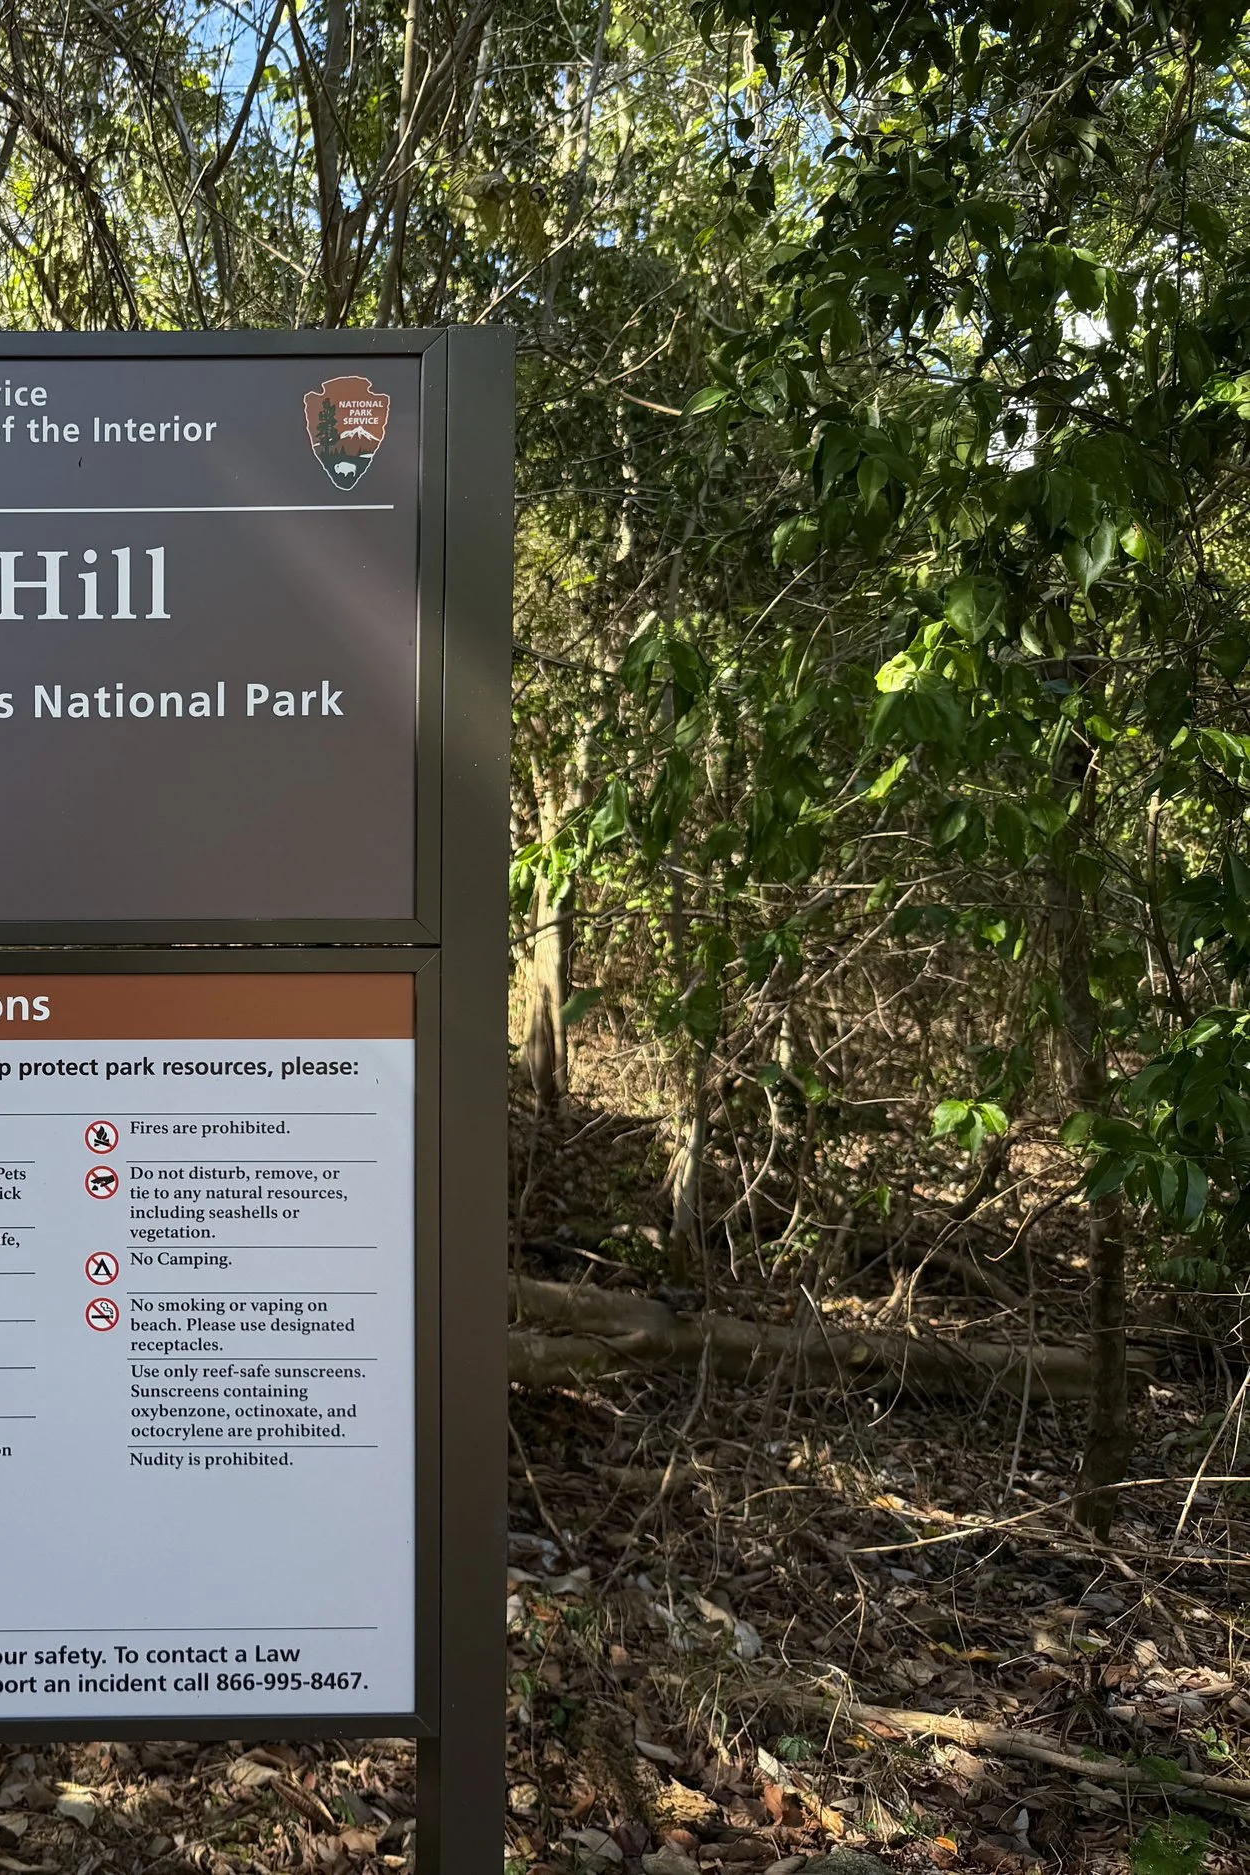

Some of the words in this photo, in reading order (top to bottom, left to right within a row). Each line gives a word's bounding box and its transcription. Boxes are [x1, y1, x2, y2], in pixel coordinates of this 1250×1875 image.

[338, 399, 384, 409] NATIONAL
[348, 408, 373, 417] PARK
[26, 415, 81, 444] the
[93, 414, 218, 443] Interior
[342, 416, 380, 426] SERVICE
[34, 680, 226, 719] National
[246, 679, 345, 717] Park
[18, 1058, 99, 1082] protect
[105, 1056, 156, 1081] park
[162, 1061, 274, 1078] resources,
[281, 1055, 359, 1081] please:
[129, 1120, 169, 1135] Fires
[172, 1124, 198, 1135] are
[201, 1120, 291, 1139] prohibited.
[129, 1166, 155, 1180] Do
[157, 1167, 185, 1180] not
[188, 1165, 251, 1183] disturb,
[254, 1169, 318, 1183] remove,
[322, 1169, 341, 1180] or
[129, 1185, 150, 1200] tie
[153, 1187, 170, 1200] to
[173, 1189, 202, 1204] any
[205, 1185, 263, 1200] natural
[266, 1188, 348, 1202] resources,
[129, 1204, 206, 1224] including
[208, 1204, 279, 1220] seashells
[281, 1208, 301, 1220] or
[129, 1224, 216, 1243] vegetation.
[129, 1251, 154, 1266] No
[156, 1251, 233, 1270] Camping.
[130, 1298, 154, 1313] No
[157, 1297, 226, 1316] smoking
[228, 1301, 248, 1312] or
[250, 1297, 304, 1316] vaping
[307, 1301, 328, 1313] on
[130, 1317, 182, 1332] beach.
[186, 1317, 237, 1332] Please
[239, 1321, 267, 1332] use
[269, 1317, 356, 1336] designated
[130, 1336, 224, 1356] receptacles.
[130, 1364, 160, 1379] Use
[163, 1363, 199, 1383] only
[202, 1363, 271, 1379] reef-safe
[274, 1367, 366, 1379] sunscreens.
[130, 1383, 220, 1398] Sunscreens
[222, 1383, 309, 1402] containing
[130, 1403, 231, 1422] oxybenzone,
[234, 1403, 323, 1420] octinoxate,
[326, 1403, 358, 1418] and
[130, 1422, 224, 1442] octocrylene
[227, 1427, 253, 1438] are
[256, 1423, 346, 1442] prohibited.
[129, 1451, 185, 1471] Nudity
[188, 1451, 201, 1466] is
[204, 1451, 294, 1470] prohibited.
[33, 1644, 107, 1670] safety.
[113, 1645, 140, 1665] To
[145, 1645, 229, 1664] contact
[234, 1648, 248, 1664] a
[255, 1644, 301, 1663] Law
[43, 1678, 71, 1694] an
[78, 1672, 168, 1693] incident
[173, 1672, 209, 1692] call
[216, 1671, 369, 1692] 866-995-8467.
